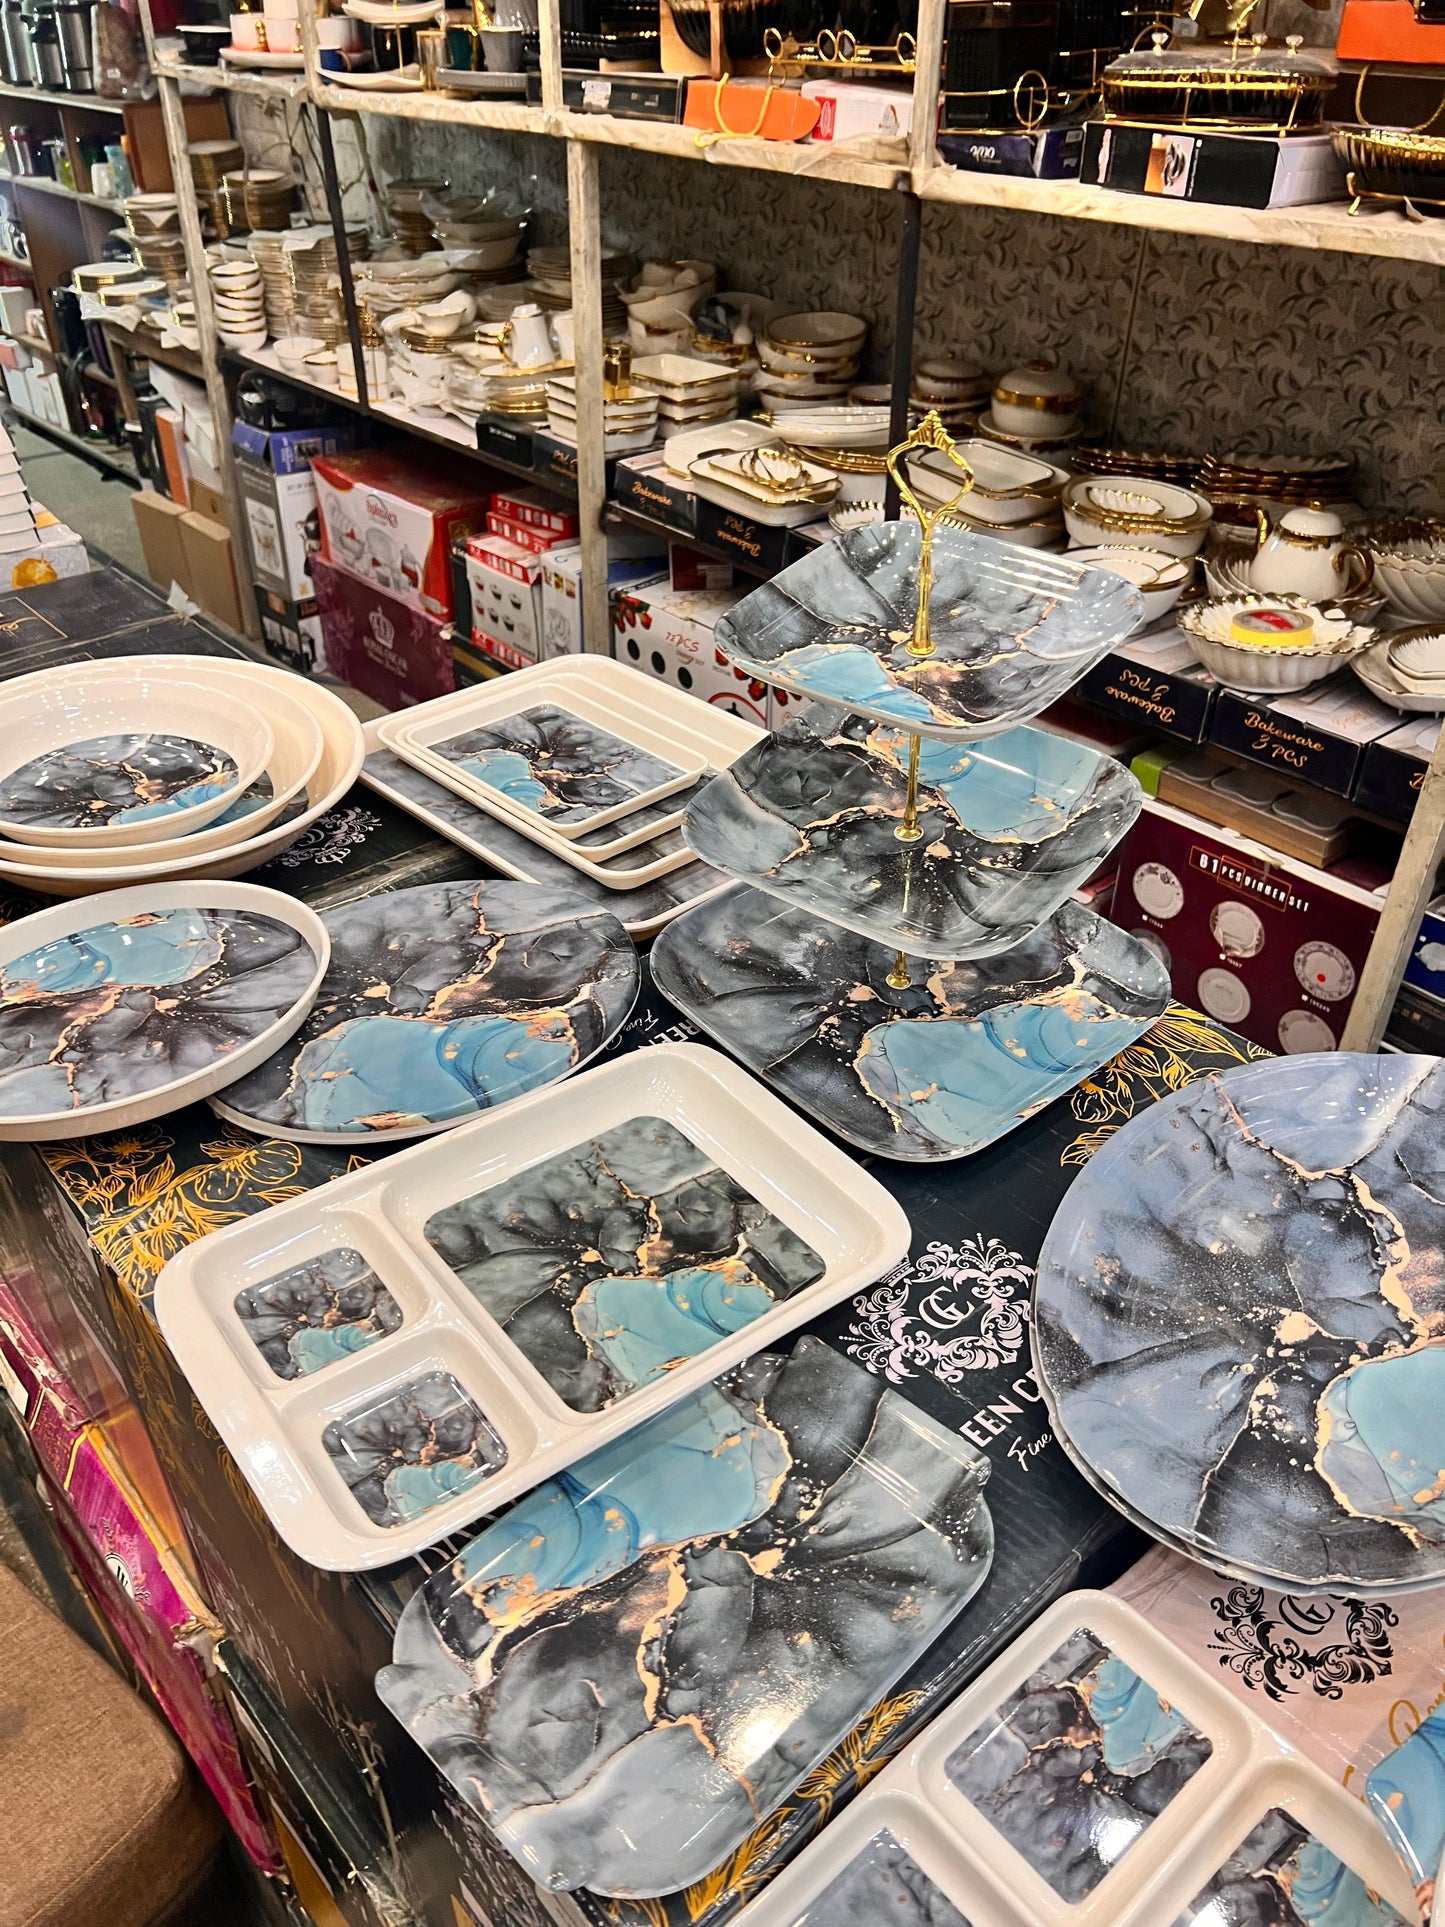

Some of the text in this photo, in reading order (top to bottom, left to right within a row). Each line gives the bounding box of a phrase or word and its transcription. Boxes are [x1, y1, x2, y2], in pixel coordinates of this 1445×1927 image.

[1119, 668, 1170, 702] 3 PCS
[1104, 685, 1176, 723] Bakeware
[1244, 711, 1325, 752] Bakeware
[1251, 733, 1308, 768] 3 PCS
[1244, 875, 1286, 903] DINNER
[1288, 895, 1309, 912] SET
[1007, 1433, 1053, 1472] Fine
